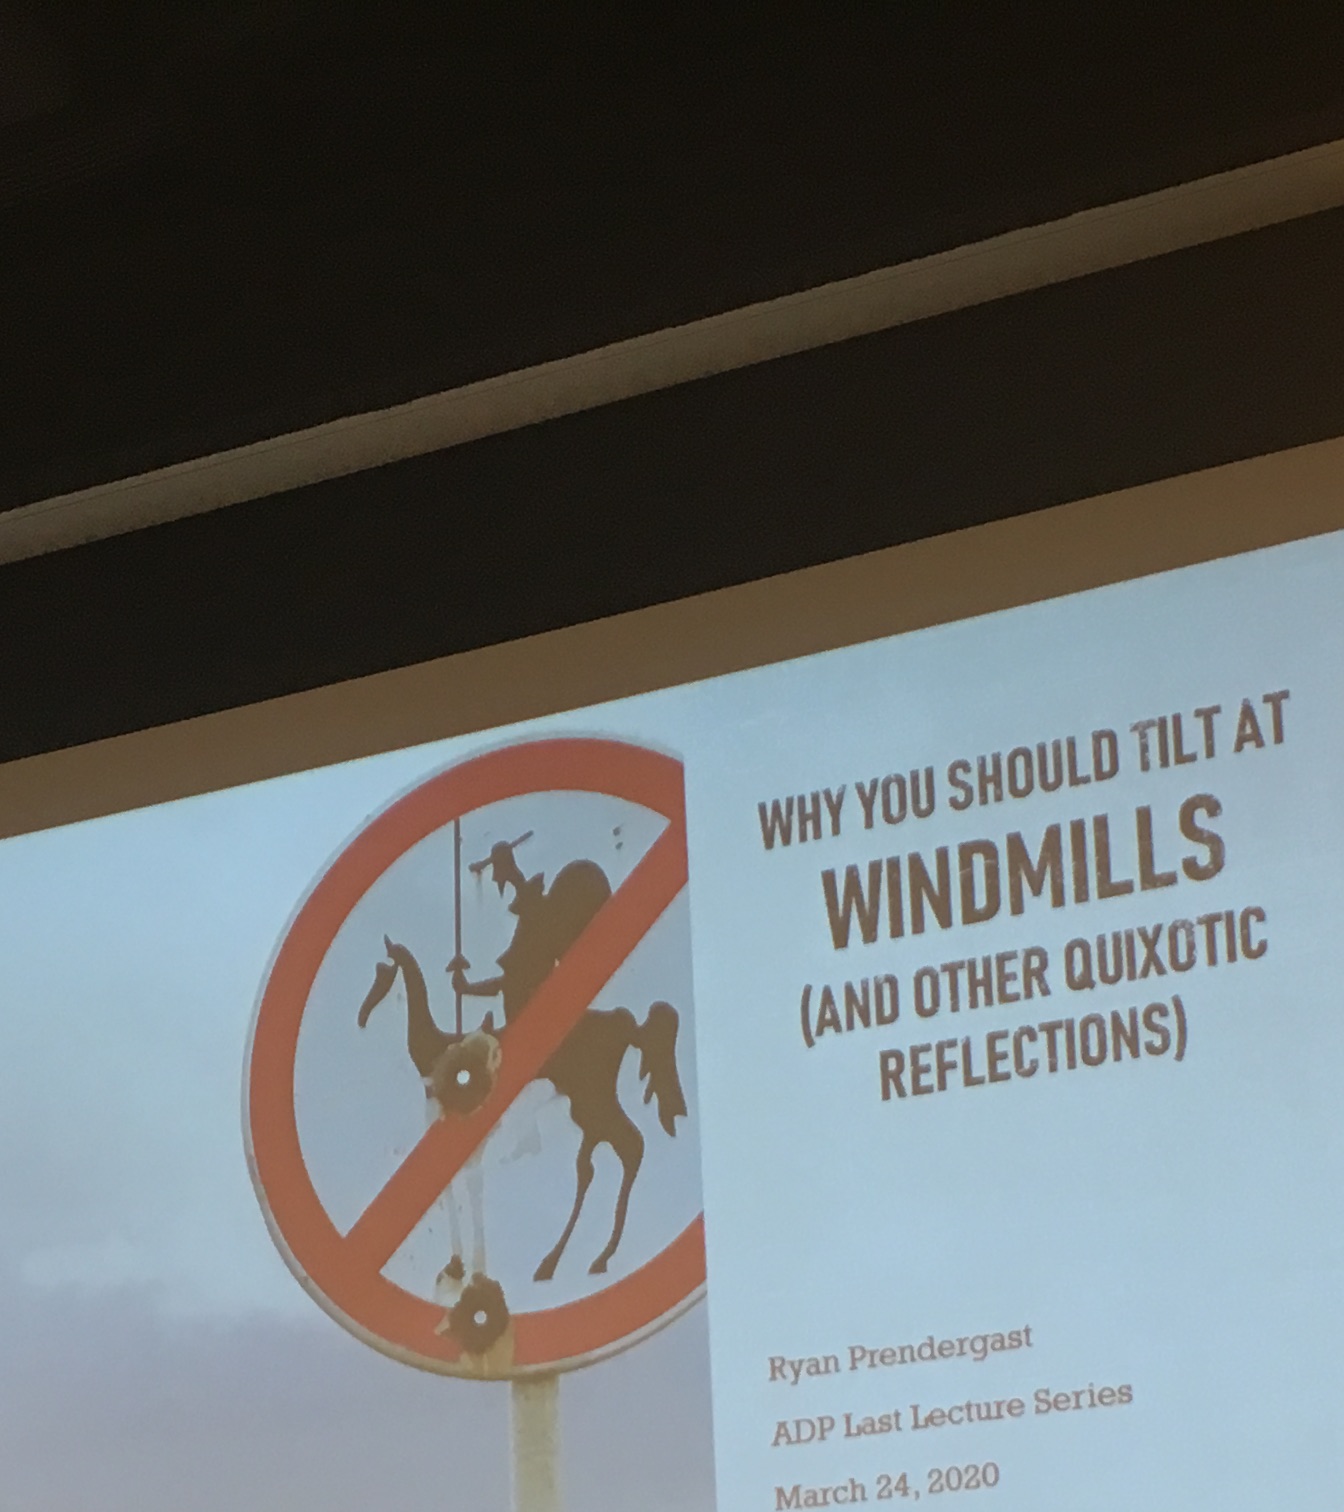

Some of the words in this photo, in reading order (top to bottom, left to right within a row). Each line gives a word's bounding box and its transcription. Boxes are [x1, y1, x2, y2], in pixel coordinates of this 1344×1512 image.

[758, 784, 846, 851] WHY
[855, 766, 935, 830] YOU
[947, 729, 1119, 812] SHOULD
[1129, 704, 1222, 773] TILT
[1233, 689, 1291, 754] AT
[821, 793, 1225, 951] WINDMILLS
[800, 973, 899, 1048] (AND
[913, 946, 1051, 1019] OTHER
[1064, 906, 1268, 991] QUIXOTIC
[880, 995, 1187, 1101] REFLECTIONS)
[768, 1353, 840, 1385] Ryan
[848, 1324, 1033, 1371] Prendergast
[771, 1416, 836, 1447] ADP
[843, 1409, 902, 1438] Last
[910, 1396, 1025, 1430] Lecture
[1034, 1383, 1134, 1414] Series
[774, 1478, 868, 1511] March
[876, 1473, 921, 1500] 24,
[927, 1462, 1000, 1494] 2020
